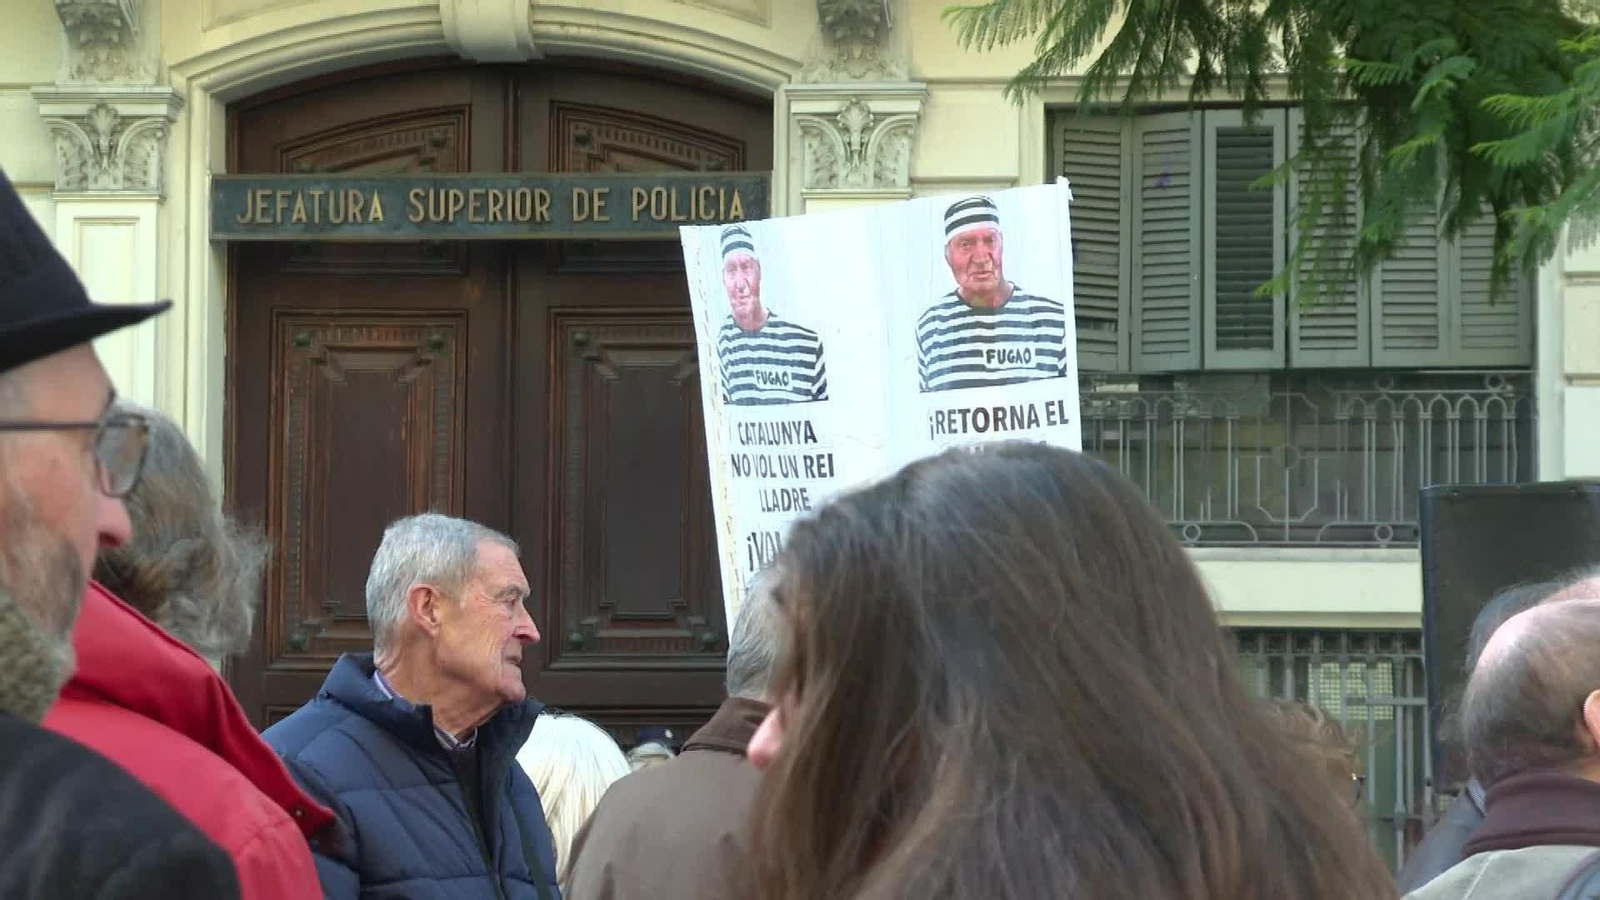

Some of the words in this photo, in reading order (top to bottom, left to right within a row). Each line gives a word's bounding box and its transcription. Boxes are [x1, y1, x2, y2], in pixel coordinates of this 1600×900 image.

[236, 189, 384, 224] JEFATURA
[408, 187, 551, 223] SUPERIOR
[573, 187, 610, 221] DE
[632, 186, 746, 221] POLICIA
[985, 348, 1032, 364] FUGAO
[755, 370, 790, 387] FUGAO
[738, 420, 818, 446] CATALUNYA
[929, 403, 1041, 440] ¡RETORNA
[1045, 400, 1069, 426] EL
[731, 453, 751, 478] NO
[752, 454, 775, 478] VOL
[779, 454, 799, 478] UN
[803, 453, 834, 478] REI
[759, 487, 812, 513] LLADRE
